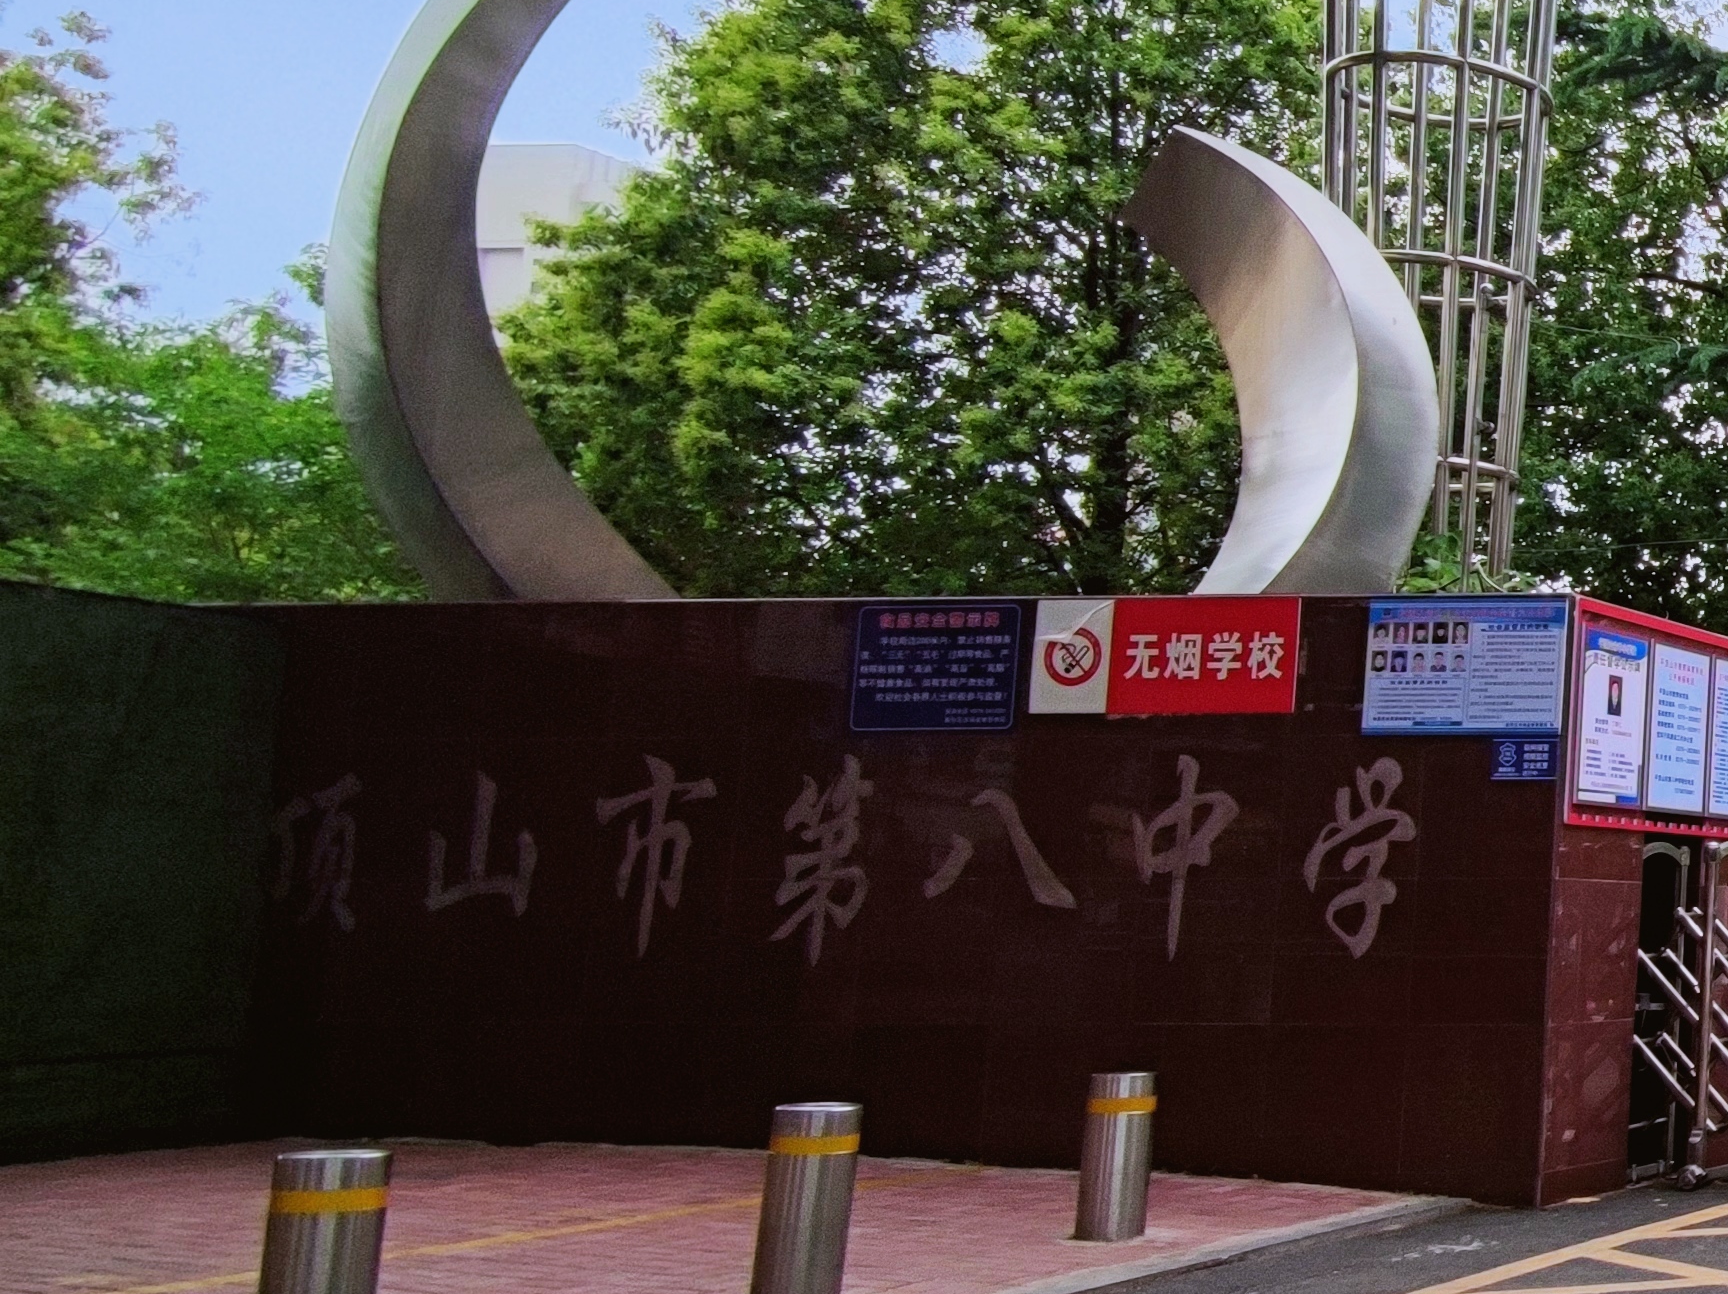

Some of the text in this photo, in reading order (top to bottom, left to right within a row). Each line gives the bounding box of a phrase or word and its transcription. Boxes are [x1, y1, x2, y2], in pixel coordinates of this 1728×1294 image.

[1123, 630, 1286, 681] 无烟学校
[270, 753, 1417, 965] 顶山市第八中学
